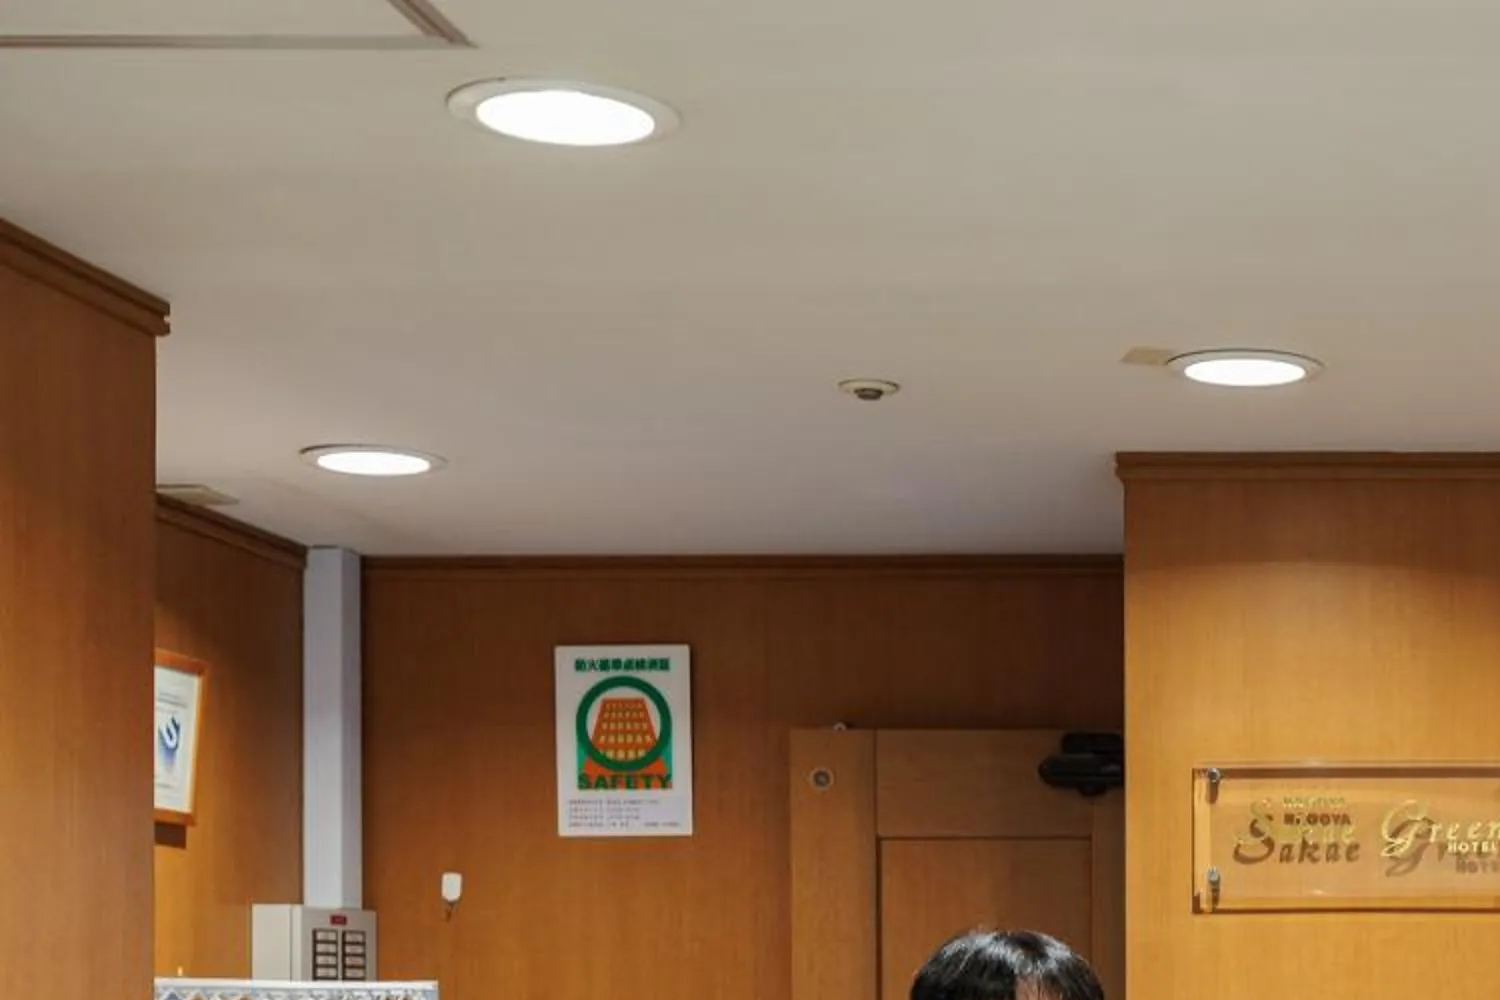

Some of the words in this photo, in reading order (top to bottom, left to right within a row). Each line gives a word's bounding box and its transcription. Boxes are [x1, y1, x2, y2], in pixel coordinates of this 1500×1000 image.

[578, 774, 672, 789] SAFETY
[1233, 797, 1359, 858] Sakae
[1448, 842, 1498, 854] HOTEL
